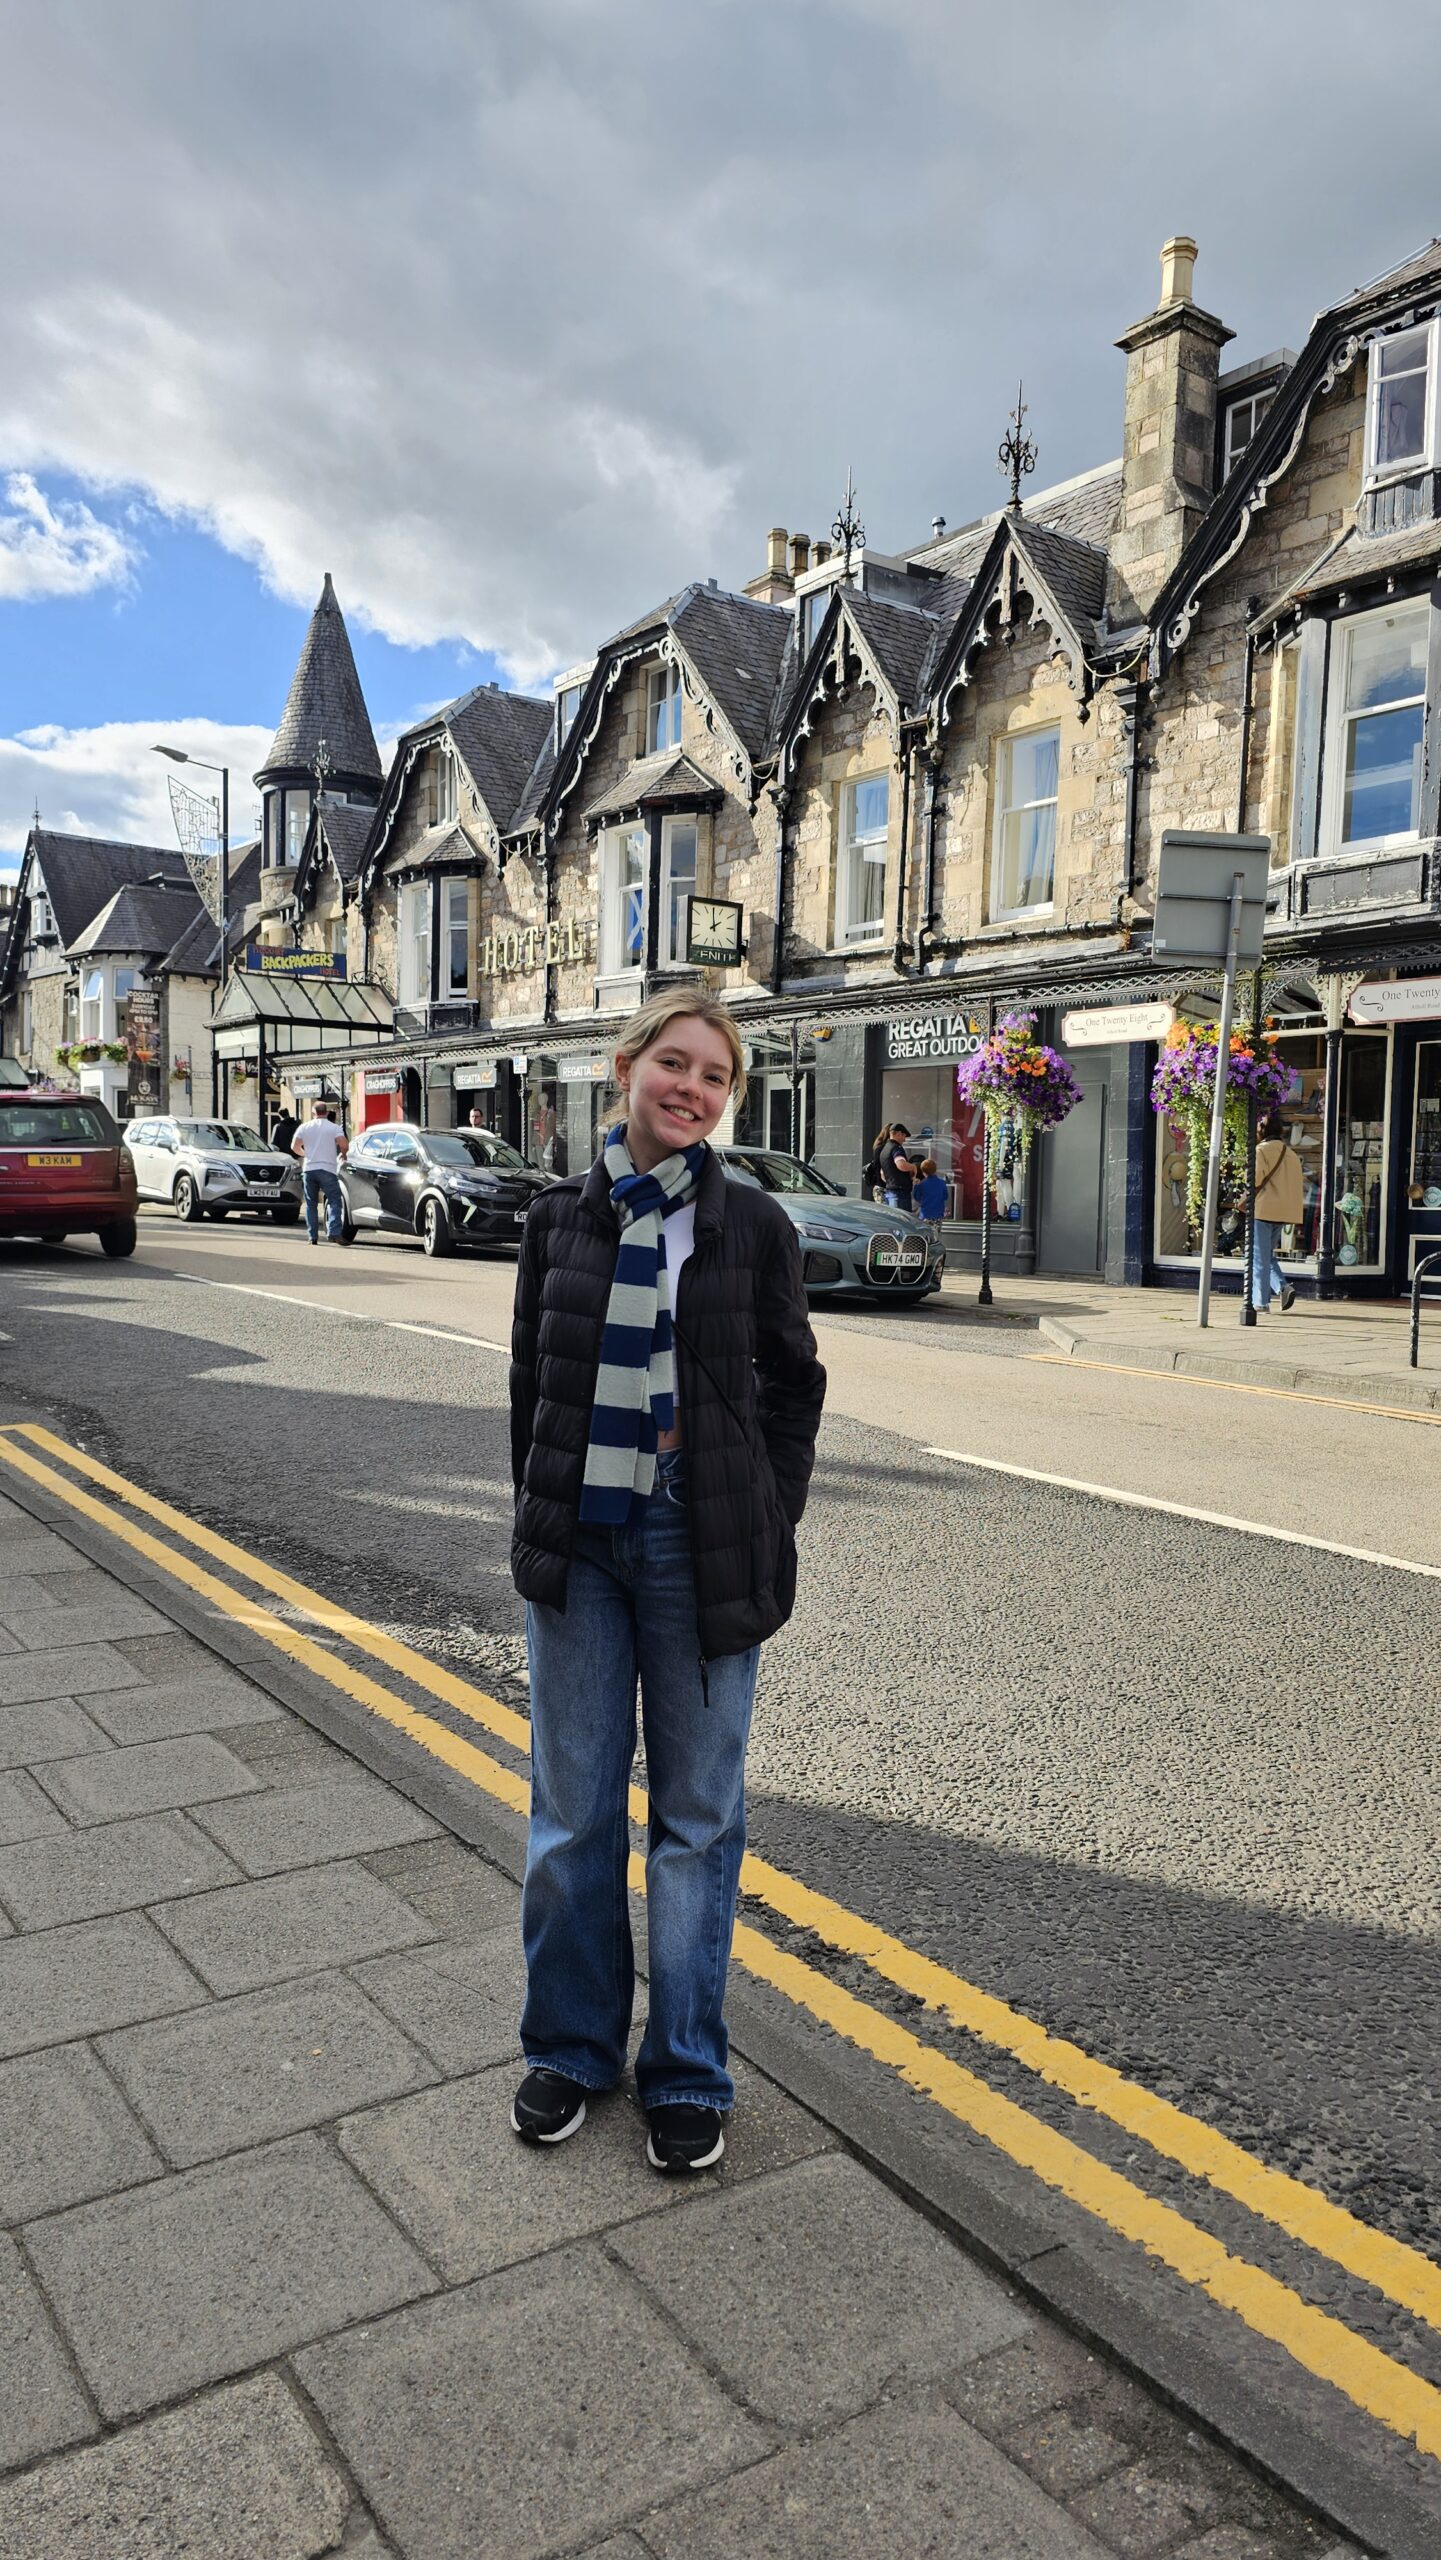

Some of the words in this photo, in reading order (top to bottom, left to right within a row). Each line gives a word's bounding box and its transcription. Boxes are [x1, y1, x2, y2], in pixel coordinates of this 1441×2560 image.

[484, 917, 584, 975] HOTEL
[261, 953, 335, 970] BACKPACKERS
[320, 967, 341, 976] HOTEL
[1382, 990, 1402, 1000] One
[1404, 988, 1440, 999] Twenty
[1085, 1017, 1100, 1027] One
[1102, 1014, 1128, 1026] Twenty
[1129, 1012, 1148, 1025] Eight
[889, 1015, 967, 1041] REGATTA
[888, 1040, 929, 1059] GREAT
[563, 1065, 592, 1077] REGATTA
[365, 1077, 397, 1090] CRAGHOPPERS
[456, 1073, 482, 1085] REGATTA
[293, 1084, 320, 1094] CRAGHOPPERS
[882, 1254, 903, 1264] HK74
[905, 1254, 920, 1264] GMO
